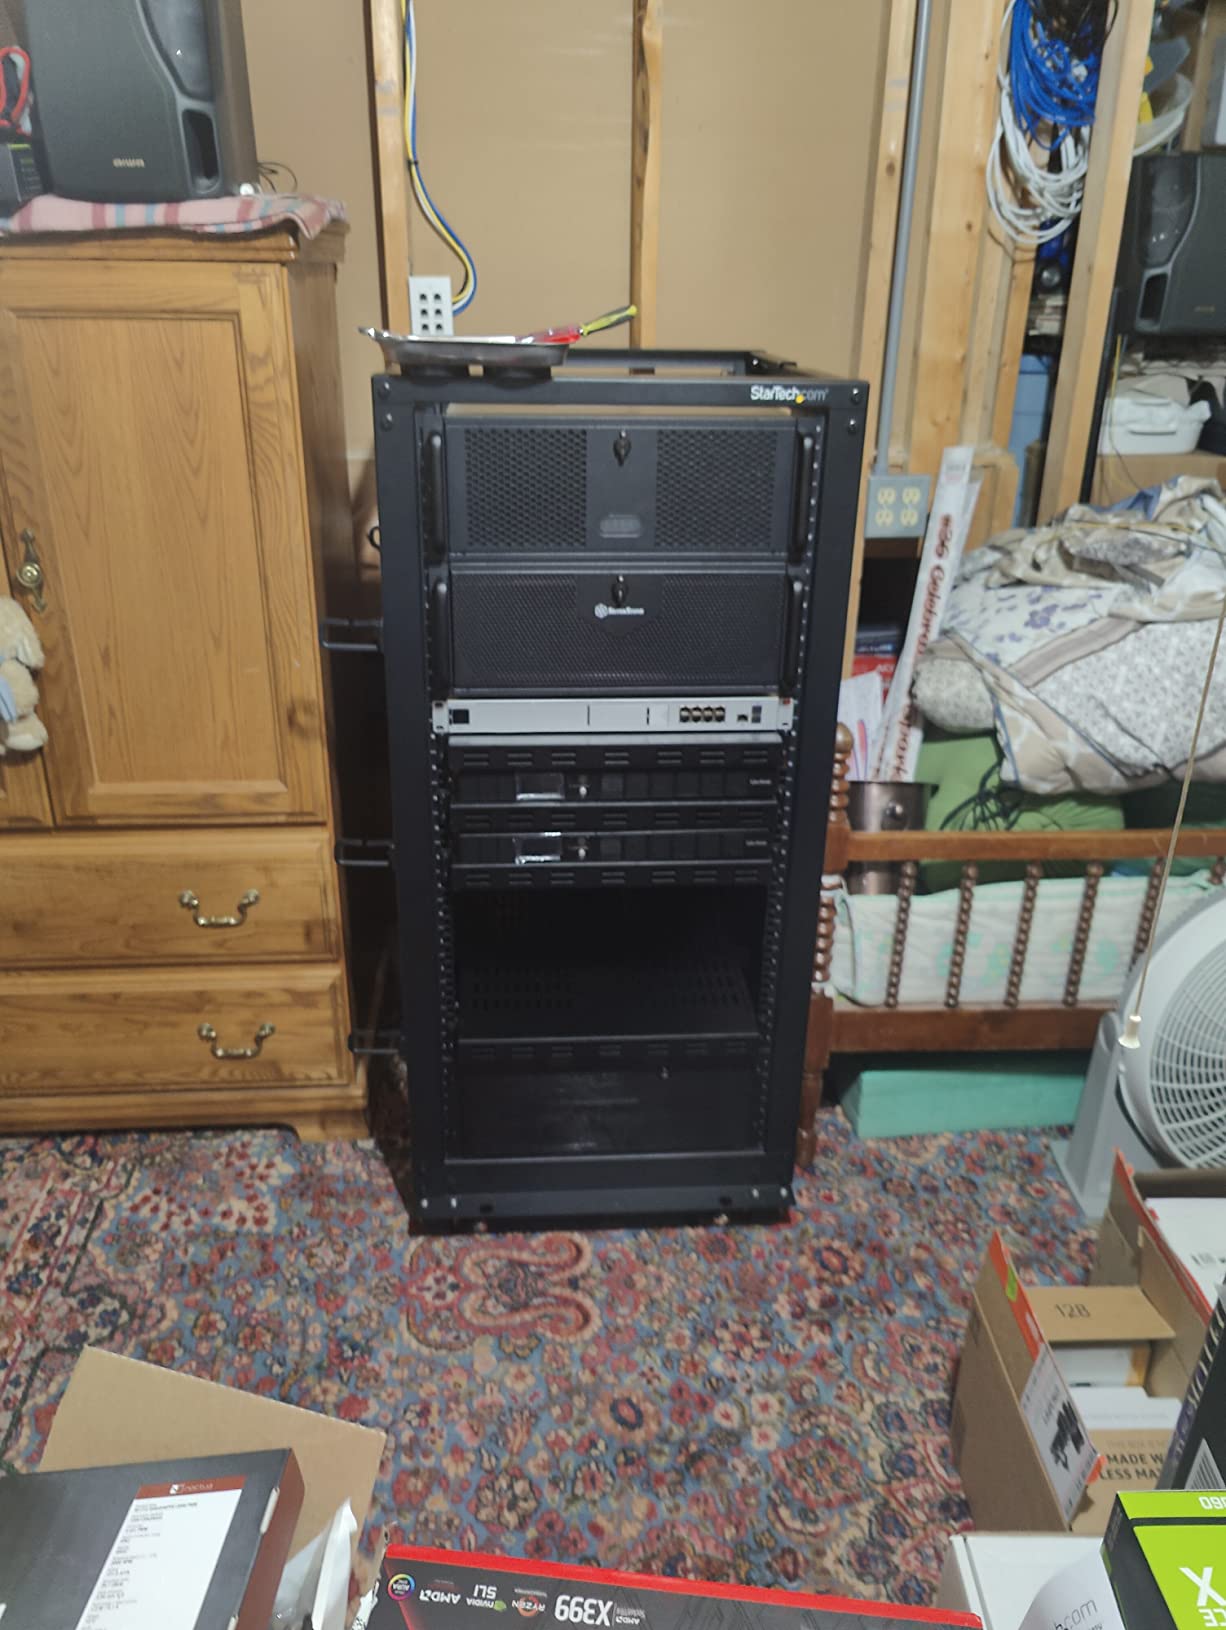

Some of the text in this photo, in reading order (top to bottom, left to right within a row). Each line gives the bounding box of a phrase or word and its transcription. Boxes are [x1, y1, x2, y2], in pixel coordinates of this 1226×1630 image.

[750, 384, 828, 404] StarTech.com
[1106, 1453, 1164, 1465] MADE W
[420, 1589, 461, 1605] AMD
[473, 1583, 497, 1600] SLI
[511, 1599, 546, 1612] RYZEN
[554, 1594, 614, 1627] X399
